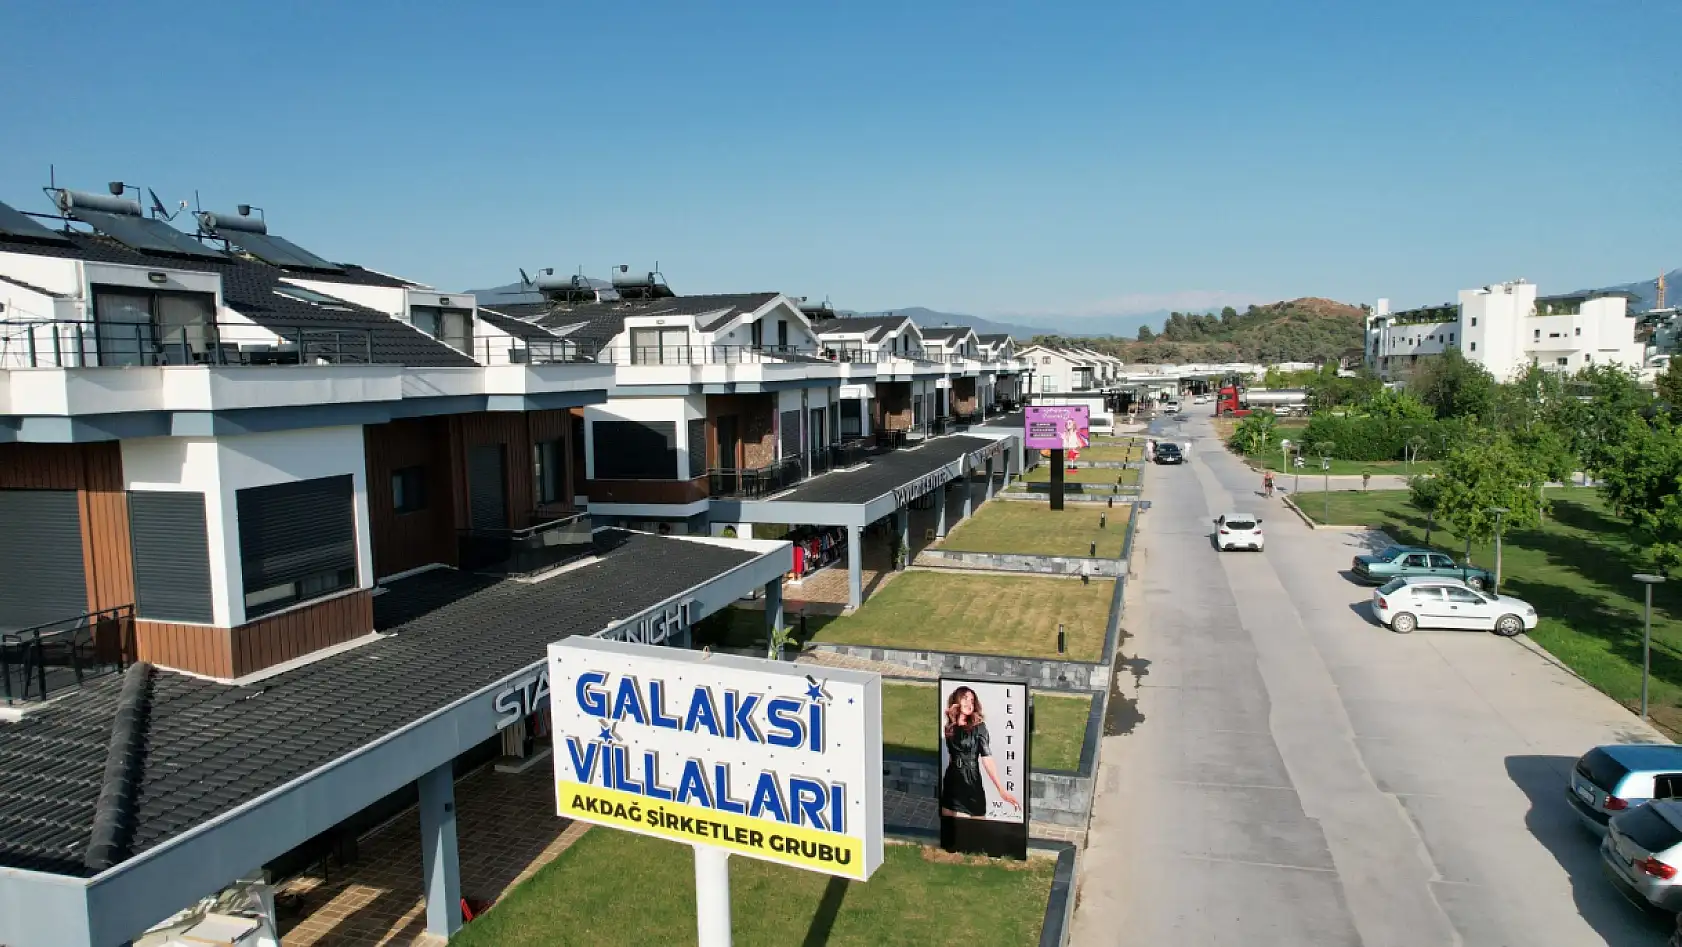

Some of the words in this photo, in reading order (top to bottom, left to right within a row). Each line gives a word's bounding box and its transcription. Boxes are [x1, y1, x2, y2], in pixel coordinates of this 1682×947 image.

[494, 670, 551, 729] STA
[575, 671, 830, 754] GALAKSİ
[1005, 688, 1015, 792] LEATHER
[565, 726, 847, 834] VİLLALARI
[571, 793, 642, 823] AKDAĞ
[646, 806, 764, 848] ŞİRKETLER
[768, 834, 852, 866] GRUBU
